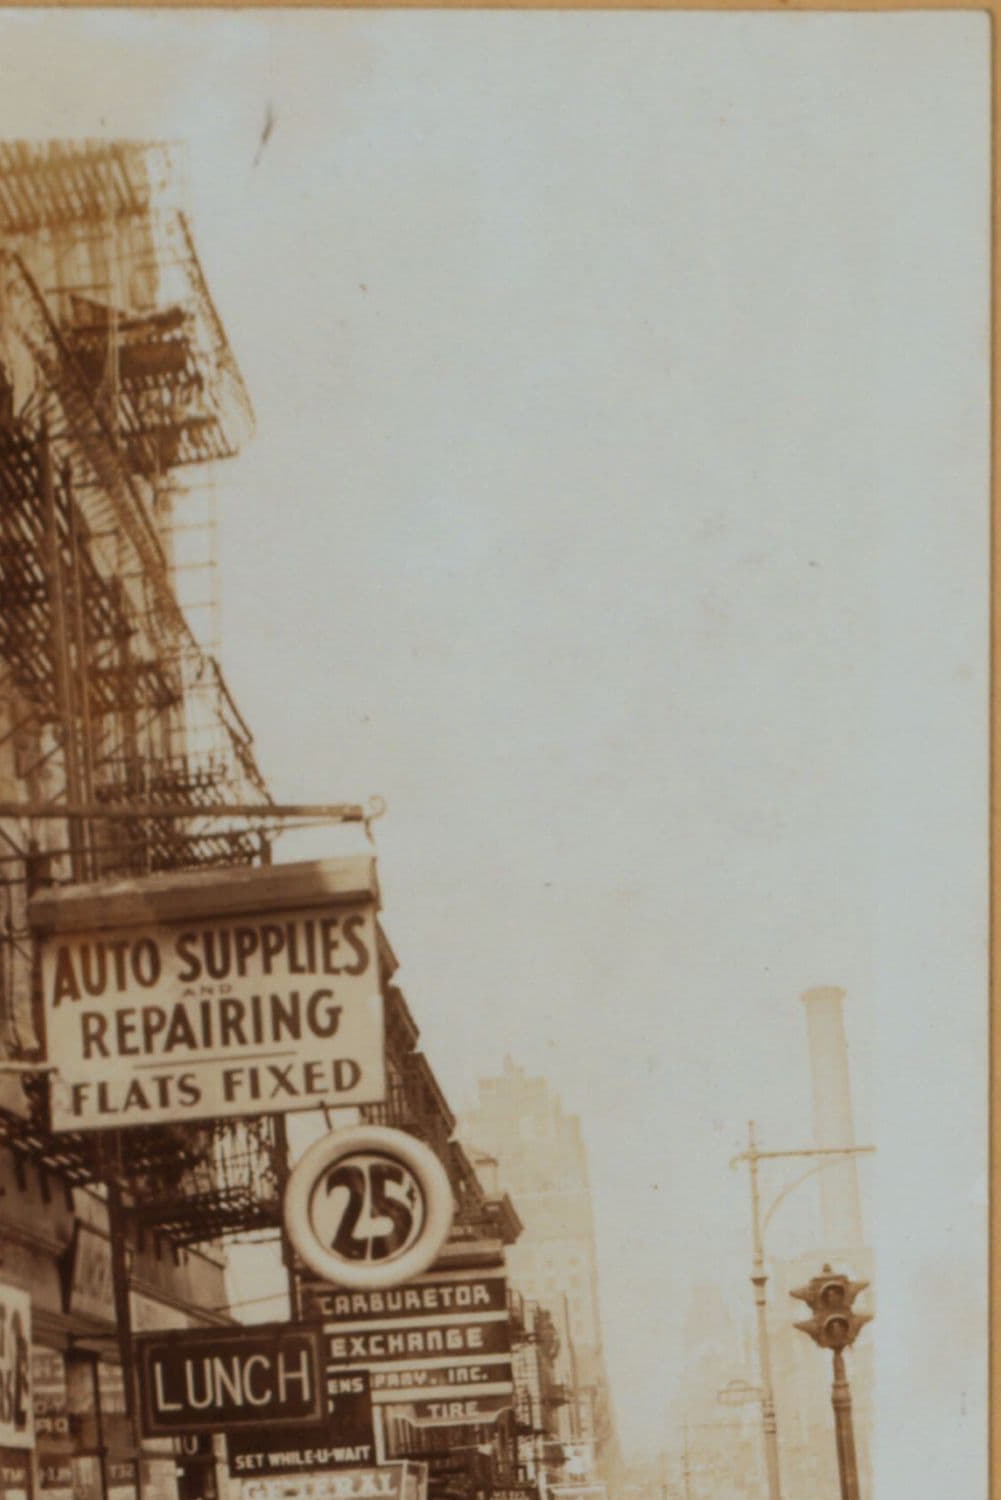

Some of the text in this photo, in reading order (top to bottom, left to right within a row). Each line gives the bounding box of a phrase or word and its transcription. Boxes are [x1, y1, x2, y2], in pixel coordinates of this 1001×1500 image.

[52, 915, 371, 1008] AUTO SUPPLIES
[182, 984, 233, 998] AND
[81, 989, 343, 1060] REPAIRING
[71, 1058, 363, 1117] FLATS FIXED
[320, 1284, 491, 1316] CARBURETOR
[330, 1327, 484, 1358] EXCHANGE
[154, 1350, 311, 1413] LUNCH
[448, 1366, 489, 1383] INC.
[427, 1401, 480, 1419] TIRE
[235, 1453, 265, 1471] SET
